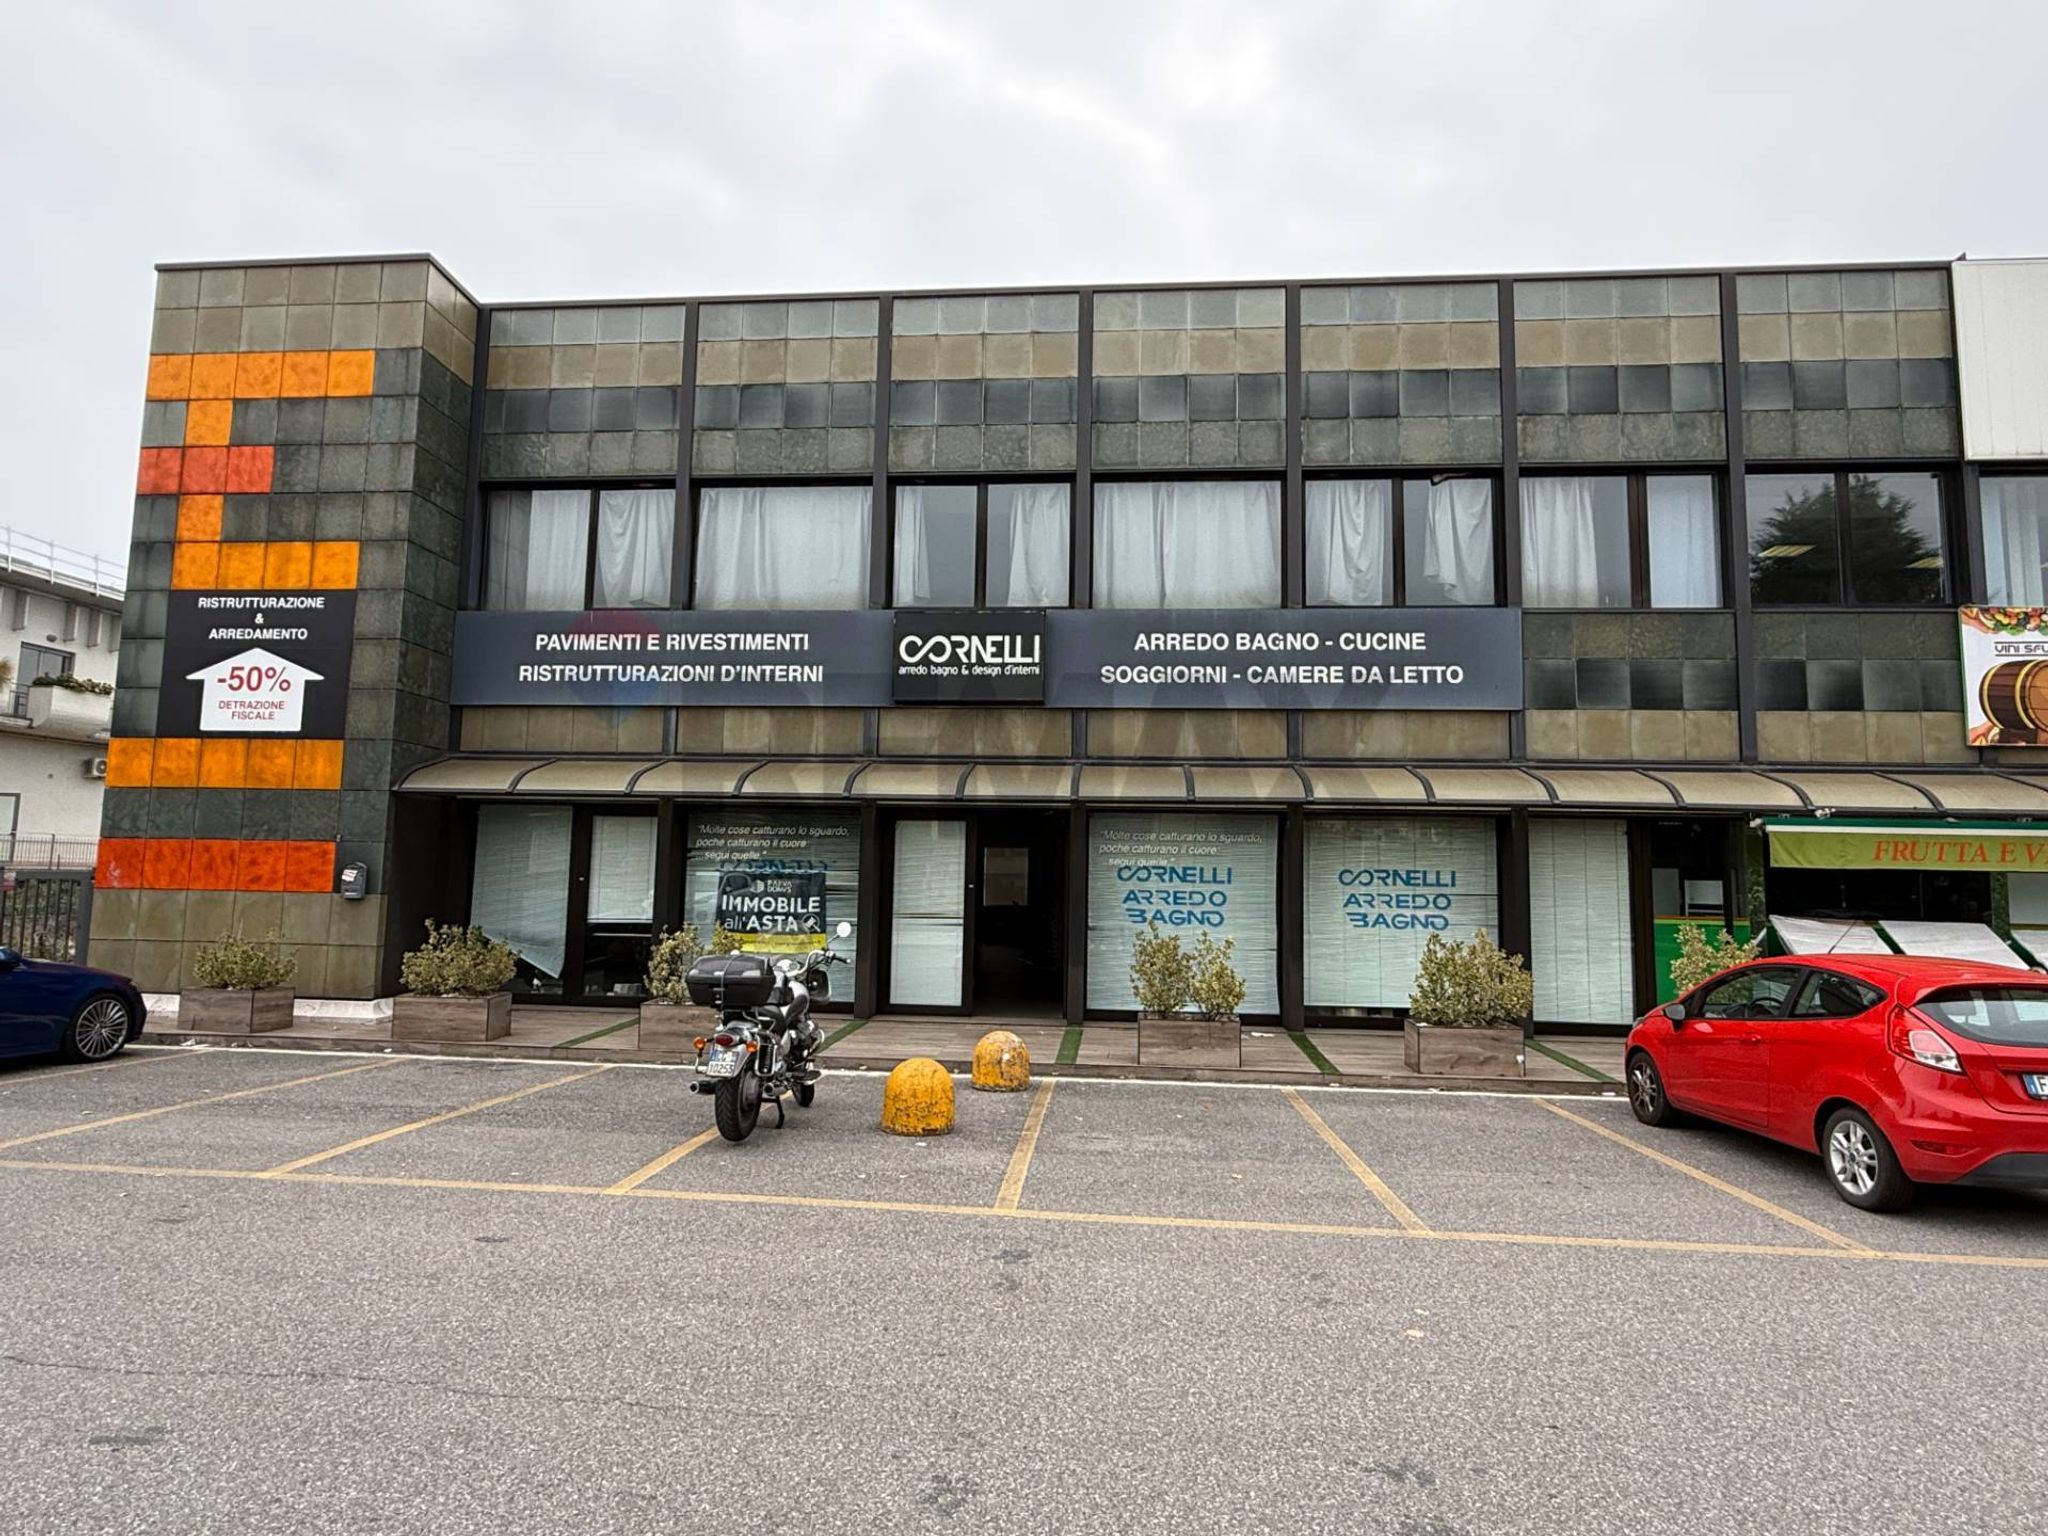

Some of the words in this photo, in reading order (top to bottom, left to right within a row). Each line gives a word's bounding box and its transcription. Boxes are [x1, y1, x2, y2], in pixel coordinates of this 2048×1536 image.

[198, 597, 325, 608] RISTRUTTURAZIONE
[255, 613, 264, 624] &
[208, 628, 308, 640] ARREDAMENTO
[535, 633, 641, 651] PAVIMENTI
[647, 634, 660, 651] E
[666, 633, 810, 651] RIVESTIMENTI
[1134, 633, 1230, 651] ARREDO
[1237, 633, 1319, 651] BAGNO
[1339, 632, 1426, 651] CUCINE
[899, 635, 1040, 663] CORNELLI
[1994, 645, 2020, 653] VINI
[217, 666, 291, 692] -50%
[519, 664, 715, 683] RISTRUTTURAZIONI
[721, 664, 823, 683] D'INTERNI
[898, 665, 928, 675] arredo
[930, 665, 958, 677] bagno
[961, 665, 969, 675] &
[972, 665, 1001, 677] design
[1004, 665, 1040, 675] d'interni
[1101, 665, 1227, 685] SOGGIORNI
[1247, 665, 1344, 685] CAMERE
[1351, 666, 1384, 684] DA
[1390, 665, 1464, 684] LETTO
[219, 701, 285, 709] DETRAZIONE
[231, 711, 275, 720] FISCALE
[727, 826, 750, 835] cose
[1132, 831, 1156, 841] cose
[696, 838, 725, 848] poche
[1099, 844, 1130, 854] poche
[1873, 840, 1990, 864] FRUTTA
[1997, 842, 2017, 863] E
[2024, 843, 2048, 864] V
[1116, 865, 1232, 884] CORNELLI
[1338, 869, 1456, 887] CORNELLI
[721, 895, 821, 913] IMMOBILE
[1122, 889, 1228, 907] ARREDO
[1343, 893, 1452, 910] ARREDO
[1125, 908, 1225, 928] BAGNO
[1346, 912, 1449, 931] BAGNO
